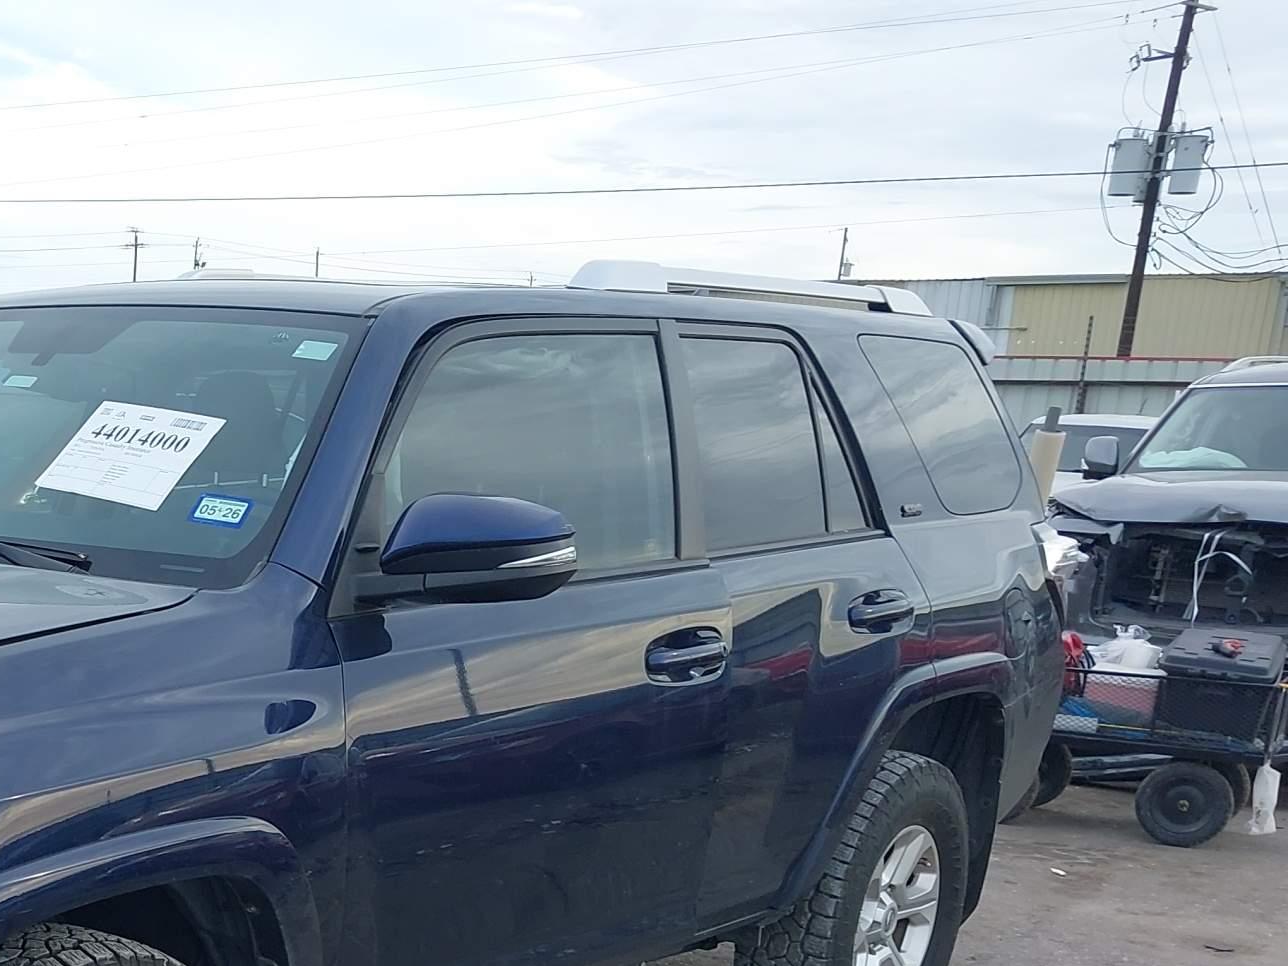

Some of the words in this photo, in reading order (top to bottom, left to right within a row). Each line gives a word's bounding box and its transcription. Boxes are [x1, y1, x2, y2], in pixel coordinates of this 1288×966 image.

[91, 423, 191, 453] 44014000
[199, 503, 218, 516] 05
[221, 507, 242, 519] 26
